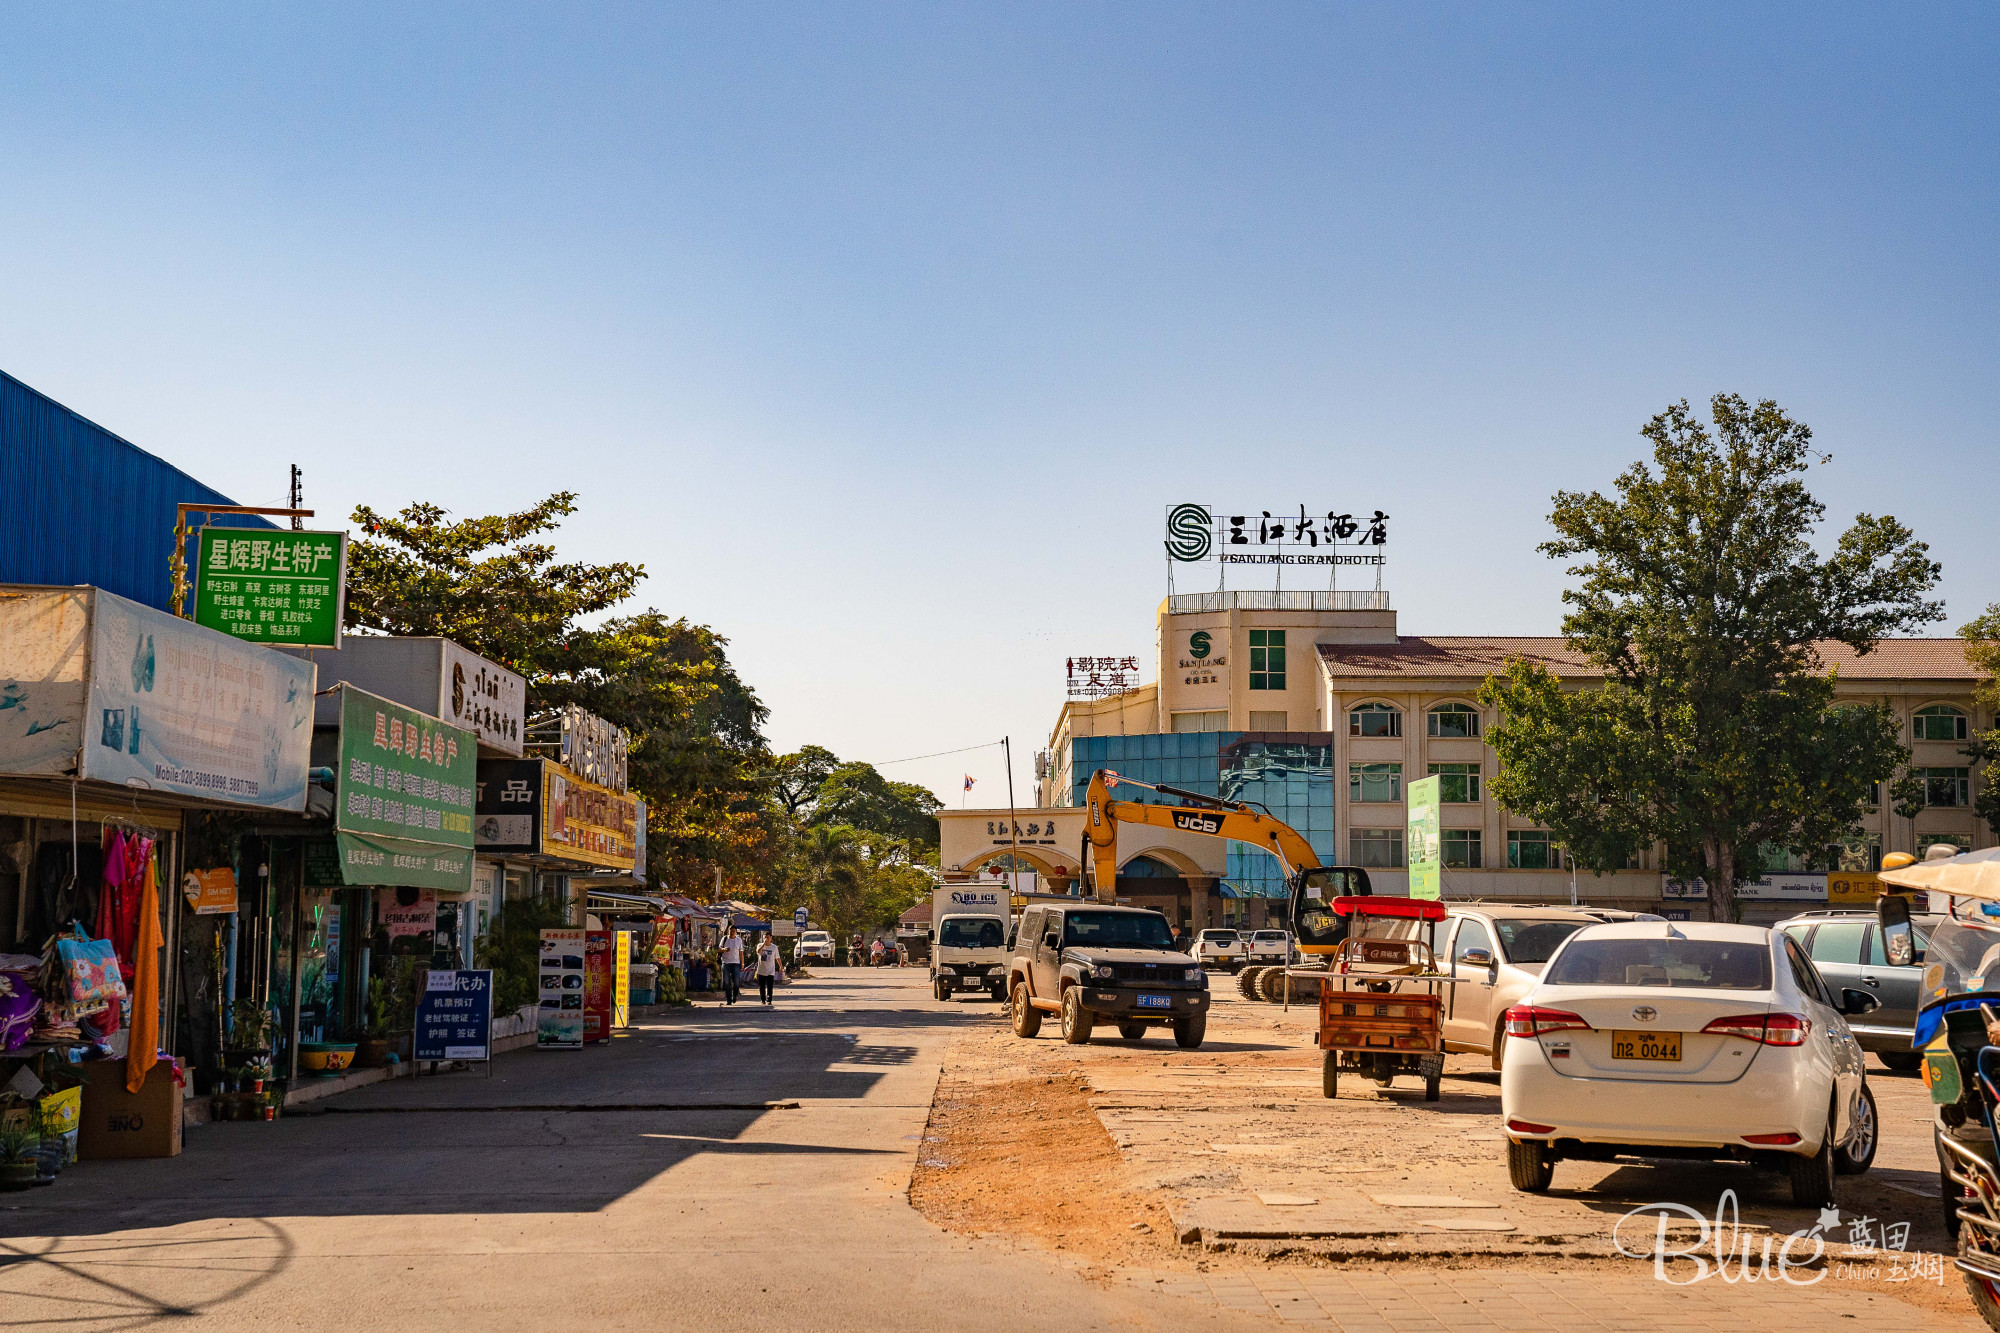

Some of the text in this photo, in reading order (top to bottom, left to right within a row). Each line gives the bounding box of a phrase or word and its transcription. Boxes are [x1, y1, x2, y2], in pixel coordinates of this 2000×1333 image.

[1230, 503, 1390, 547] 三江大酒店
[208, 539, 332, 573] 星辉野生特产
[1230, 554, 1294, 564] SANJIANG
[245, 582, 261, 593] 燕窝
[269, 583, 291, 595] 古树茶
[298, 584, 330, 596] 东革阿里
[213, 595, 245, 607] 野生蜂蜜
[220, 609, 252, 620] 进口零食
[259, 610, 275, 621] 香烟
[270, 625, 300, 636] 饰品系列
[1077, 656, 1138, 672] 影院式
[1179, 657, 1226, 668] SANJIANG
[1086, 673, 1128, 687] 足道
[373, 711, 458, 769] 星辉野生特产
[1178, 815, 1217, 833] JCB
[1315, 917, 1336, 930] JCB
[455, 976, 486, 991] 代办
[433, 998, 473, 1008] 机票预订
[424, 1013, 469, 1023] 老挝驾驶证
[428, 1028, 477, 1039] 护照 签证
[1641, 1043, 1677, 1058] 0044
